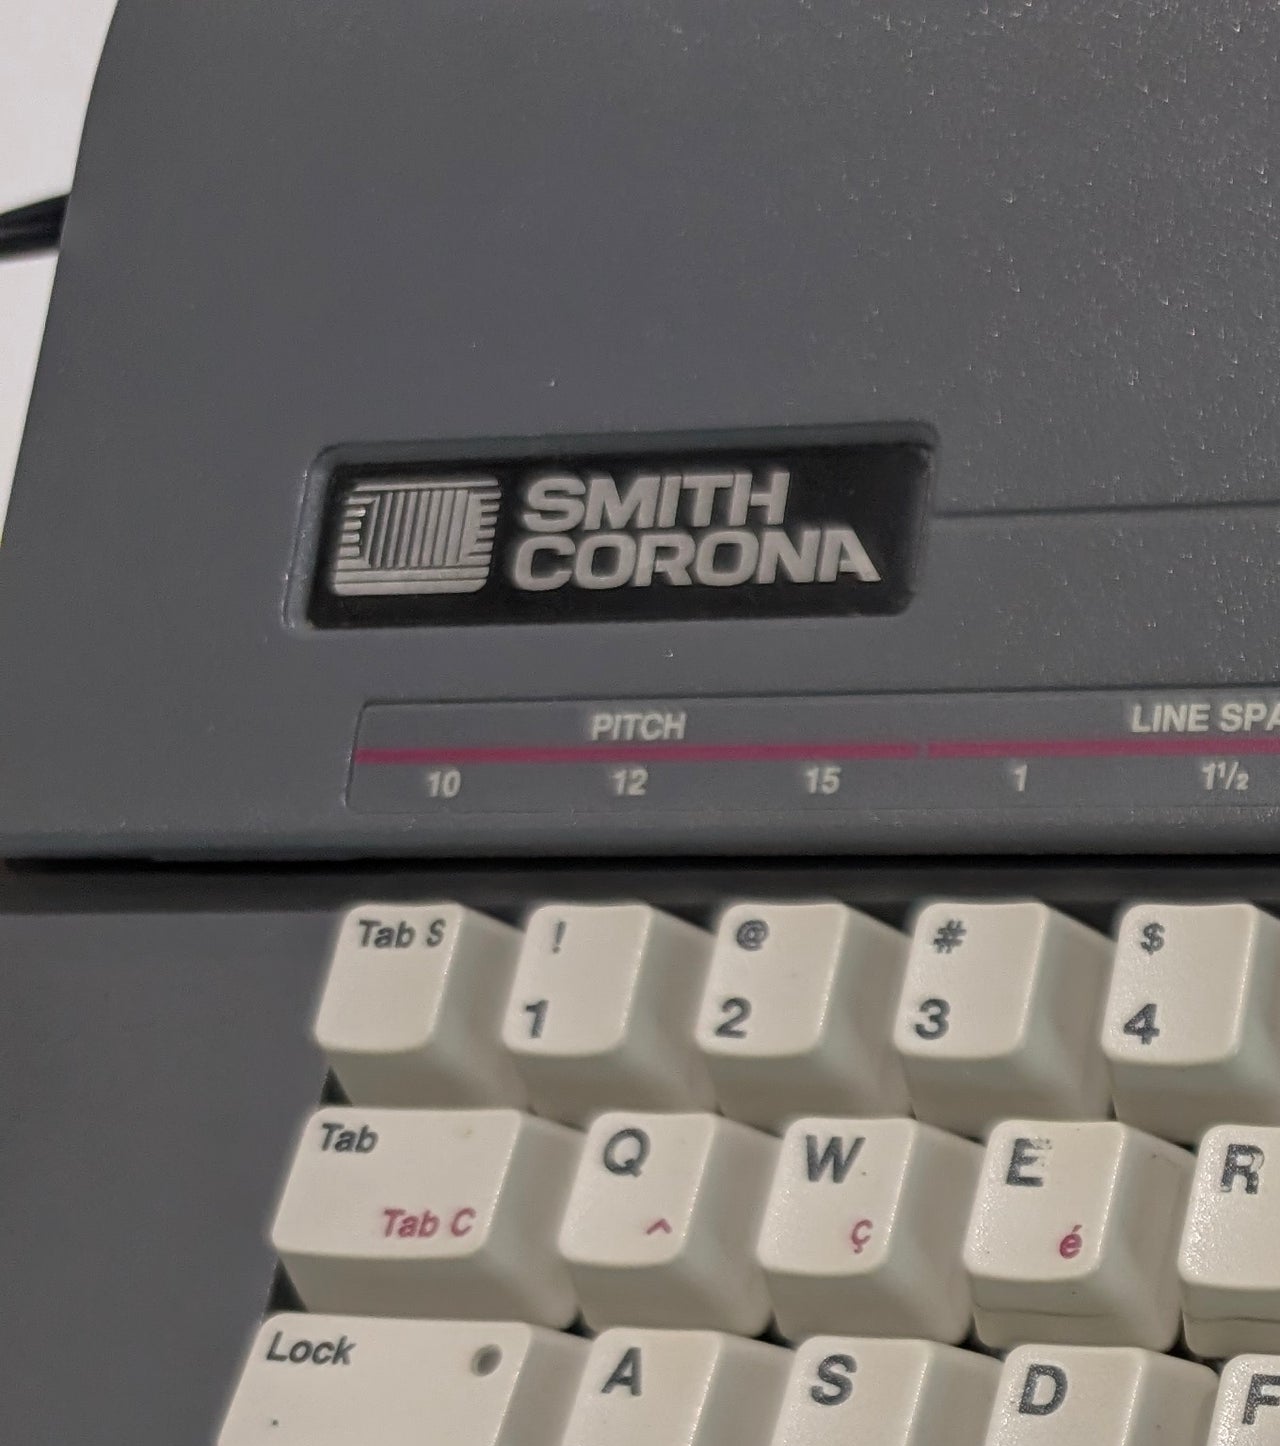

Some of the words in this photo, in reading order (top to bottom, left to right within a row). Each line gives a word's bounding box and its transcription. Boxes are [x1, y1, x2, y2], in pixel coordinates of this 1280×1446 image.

[520, 470, 791, 532] SMITH
[511, 524, 881, 591] CORONA
[590, 712, 687, 741] PITCH
[1130, 702, 1209, 733] LINE
[426, 770, 461, 798] 10
[611, 770, 648, 797] 12
[806, 767, 841, 794] 15
[1013, 764, 1028, 791] 1
[359, 919, 415, 949] Tab
[425, 918, 445, 948] S
[552, 921, 566, 954] !
[735, 919, 768, 951] @
[933, 920, 966, 953] #
[1140, 922, 1164, 955] $
[524, 1000, 547, 1038] 1
[715, 997, 750, 1038] 2
[914, 998, 948, 1040] 3
[1123, 1003, 1160, 1045] 4
[321, 1122, 377, 1153] Tab
[602, 1128, 648, 1177] Q
[805, 1135, 864, 1183] W
[1005, 1137, 1052, 1188] E
[1220, 1143, 1263, 1194] R
[383, 1208, 439, 1238] Tab
[450, 1207, 475, 1237] C
[1058, 1225, 1081, 1259] é
[265, 1331, 354, 1365] Lock
[601, 1347, 640, 1396] A
[810, 1354, 855, 1406] S
[1017, 1364, 1068, 1416] D
